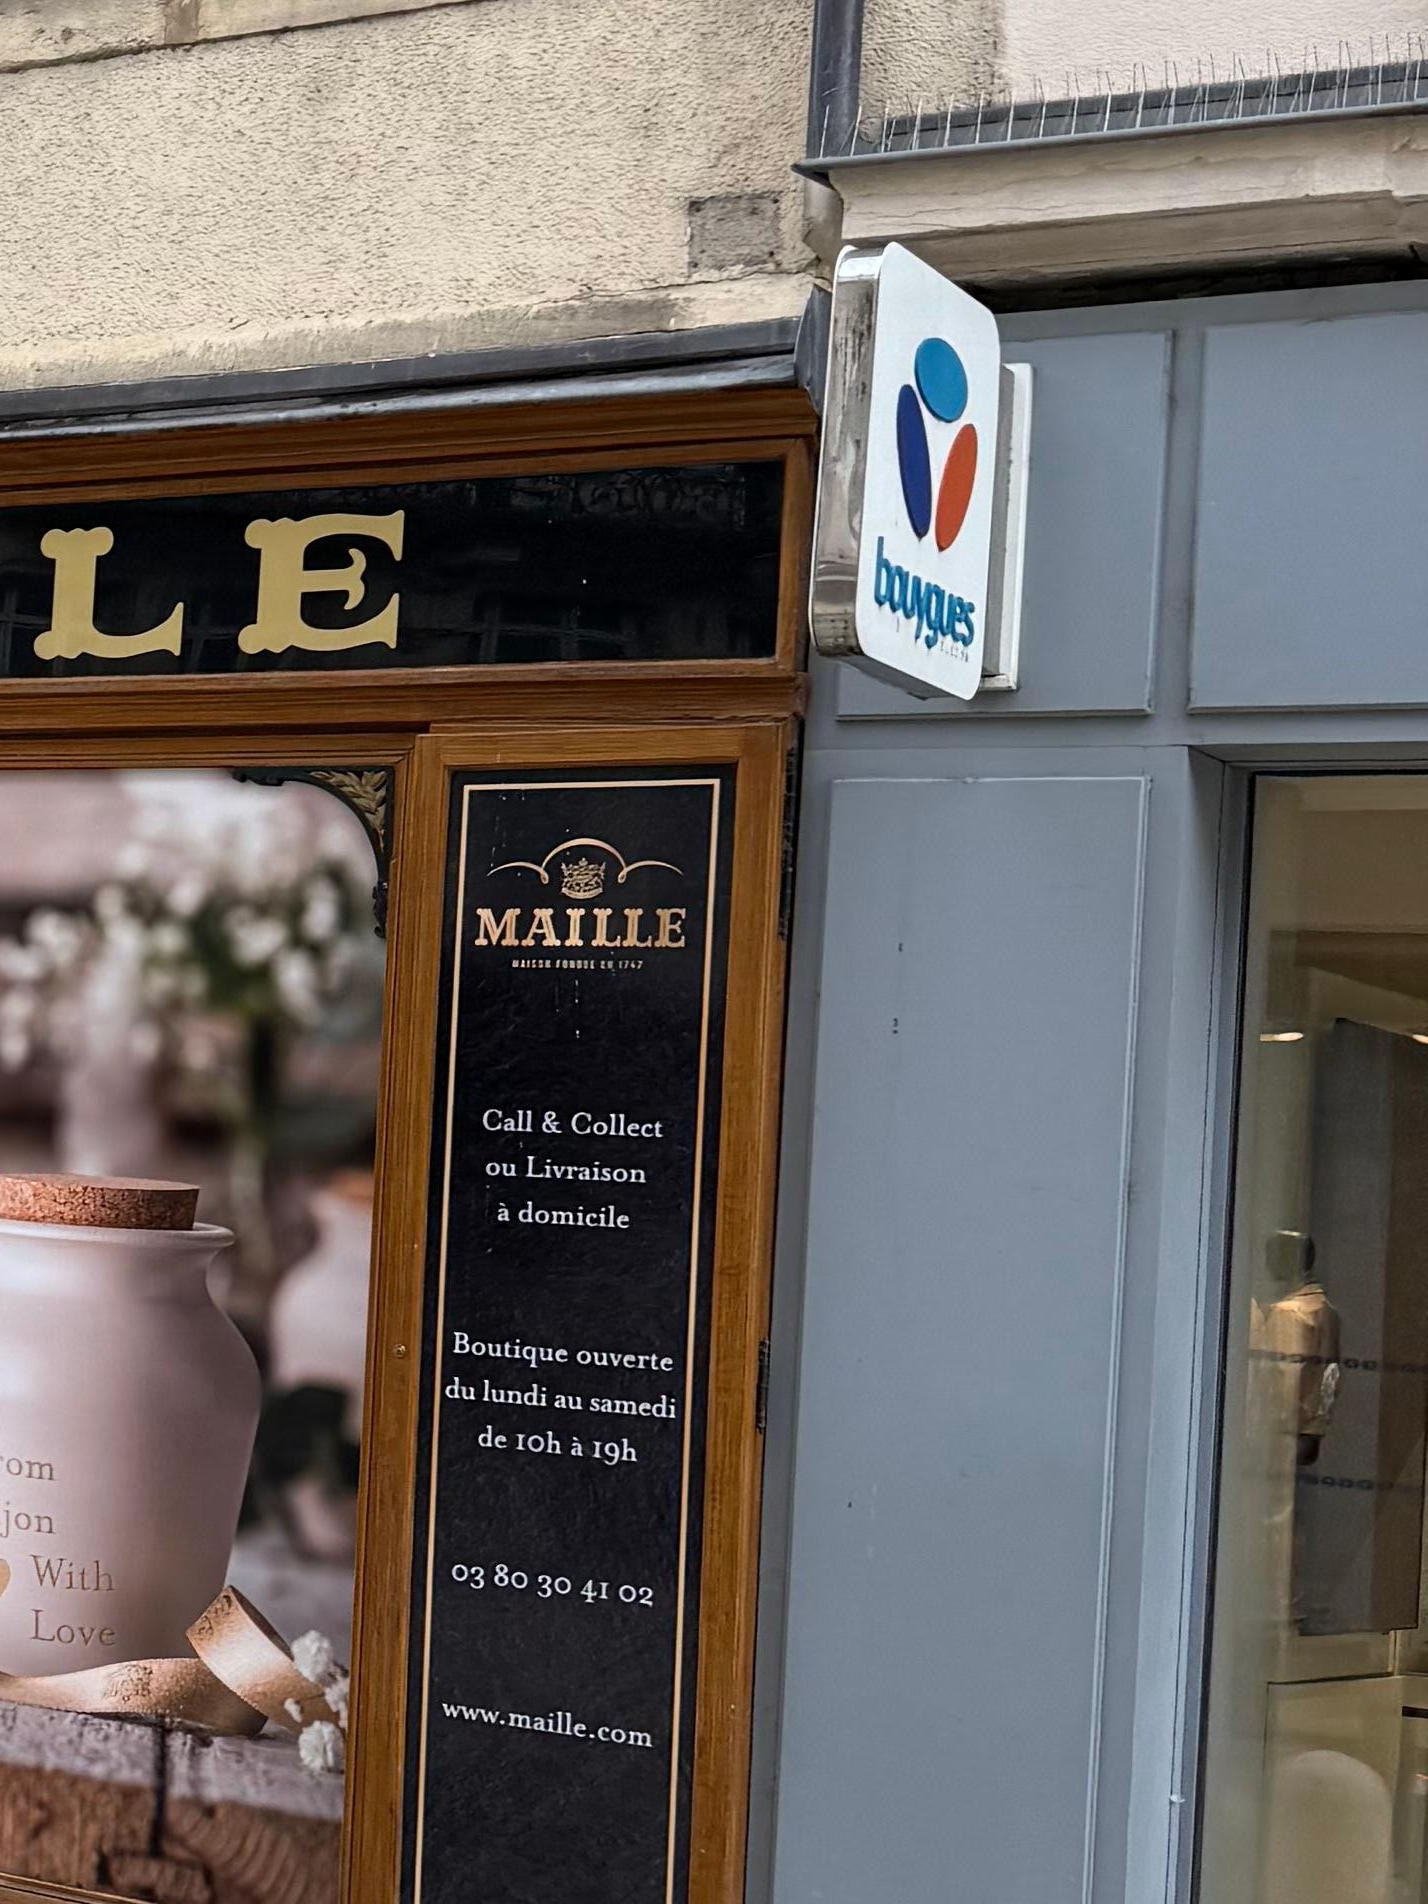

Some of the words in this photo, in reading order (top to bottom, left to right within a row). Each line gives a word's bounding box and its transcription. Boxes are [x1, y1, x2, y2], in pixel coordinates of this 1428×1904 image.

[873, 535, 976, 650] bouygues
[474, 907, 687, 948] MAILLE
[618, 960, 644, 969] 1747
[482, 1108, 533, 1132] Call
[541, 1110, 563, 1133] &
[570, 1112, 664, 1138] Collect
[485, 1160, 517, 1177] ou
[525, 1155, 647, 1183] Livraison
[496, 1202, 511, 1222] à
[517, 1200, 630, 1229] domicile
[452, 1331, 569, 1368] Boutique
[576, 1348, 674, 1372] ouverte
[445, 1376, 476, 1401] du
[482, 1379, 547, 1407] lundi
[553, 1394, 582, 1410] au
[589, 1394, 677, 1419] samedi
[477, 1424, 508, 1449] de
[516, 1430, 562, 1455] 10h
[570, 1437, 584, 1457] à
[591, 1438, 638, 1466] 19h
[28, 1553, 115, 1592] With
[451, 1563, 485, 1590] 03
[494, 1563, 528, 1589] 80
[537, 1574, 572, 1598] 30
[580, 1579, 610, 1603] 41
[618, 1584, 654, 1608] 02
[30, 1608, 116, 1647] Love
[441, 1702, 654, 1748] www.maille.com
